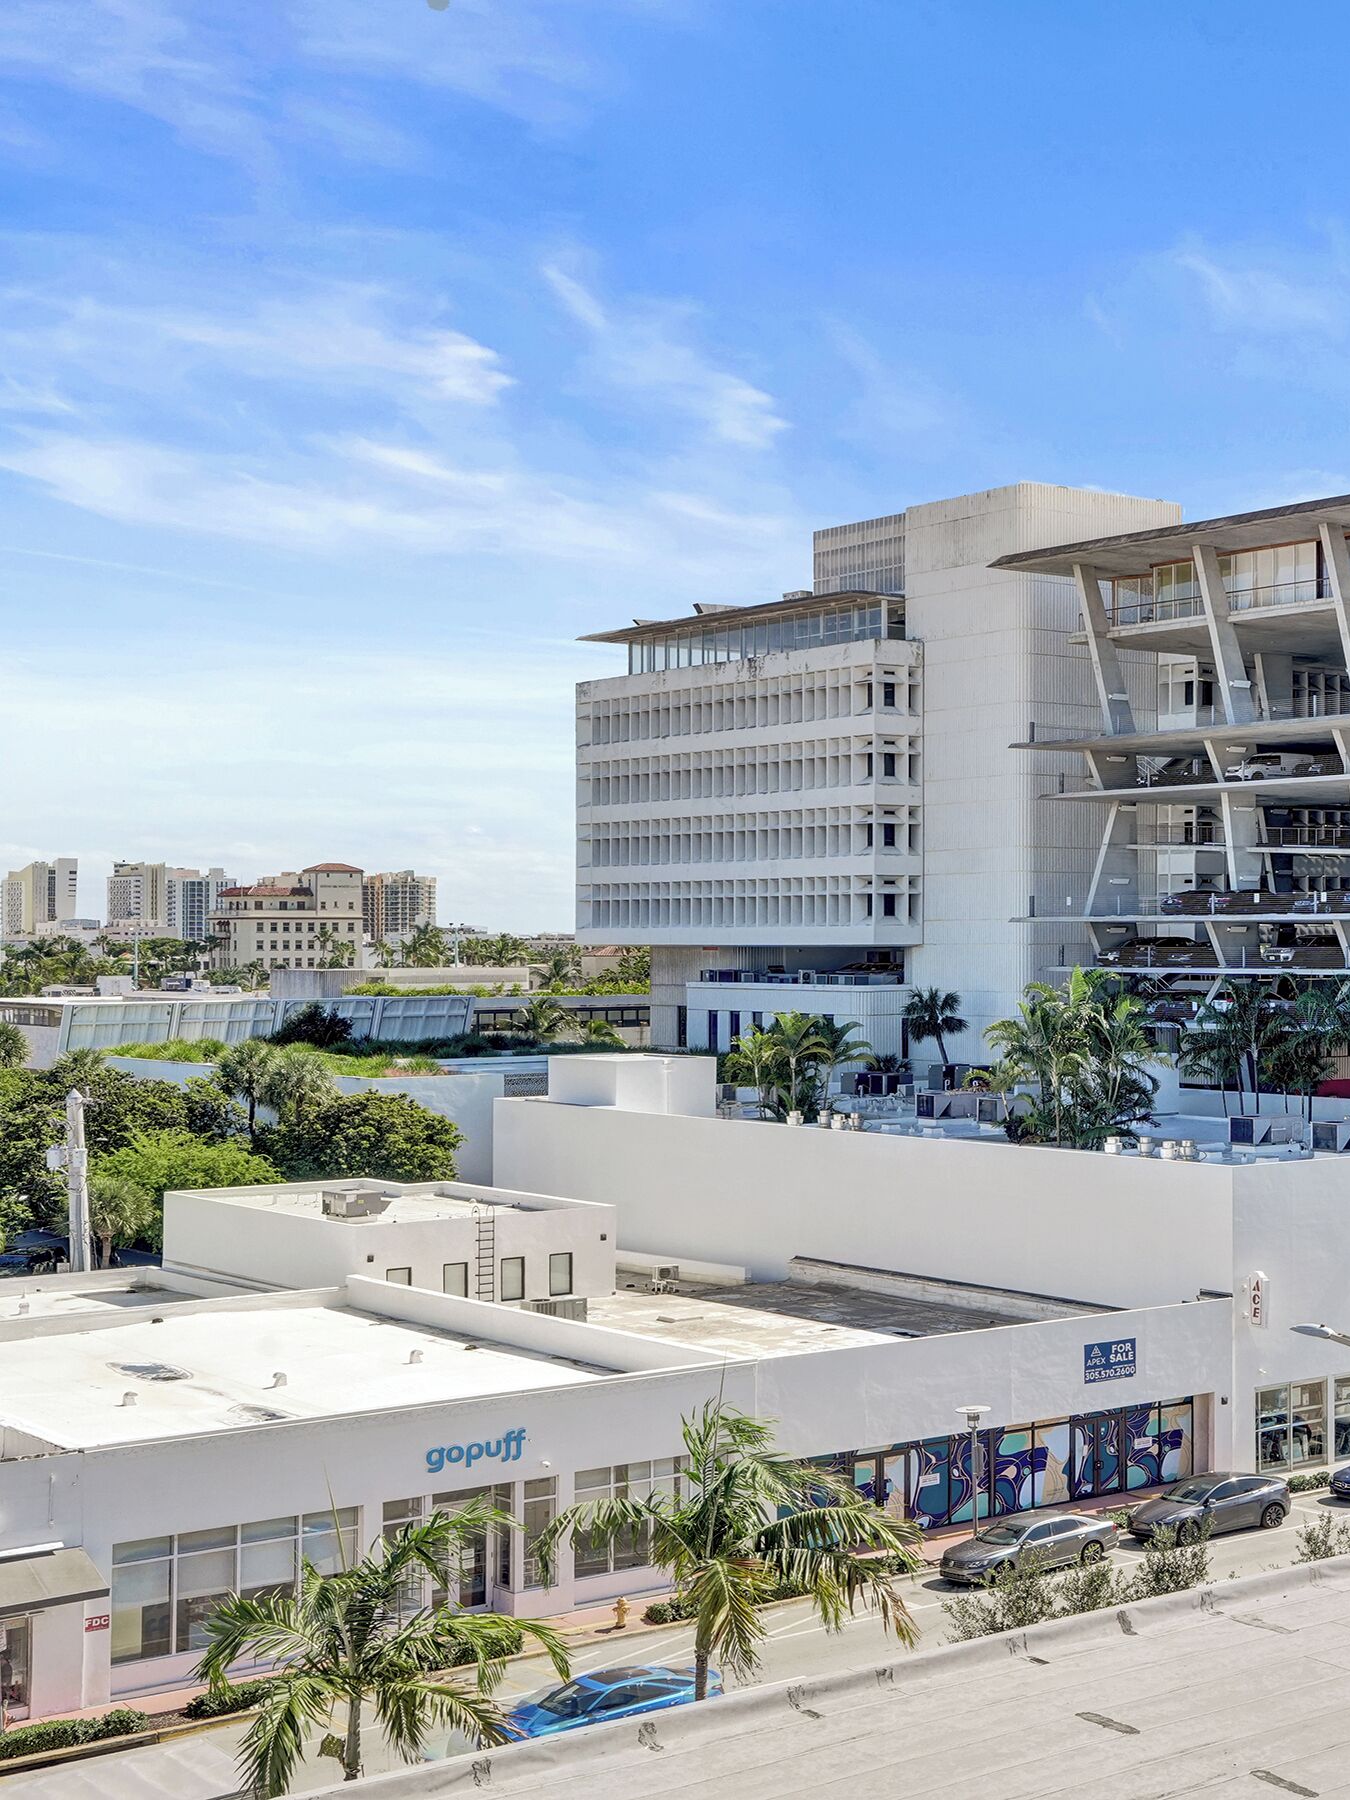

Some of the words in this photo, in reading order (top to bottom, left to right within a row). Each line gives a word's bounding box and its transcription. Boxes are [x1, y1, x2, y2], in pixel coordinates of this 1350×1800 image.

[1252, 1279, 1261, 1318] ACE
[1111, 1343, 1132, 1354] FOR
[1086, 1357, 1106, 1367] APEX
[1109, 1351, 1134, 1363] SALE
[1085, 1366, 1136, 1381] 305.570.2600
[425, 1428, 527, 1473] gopuff
[85, 1616, 109, 1628] FDC
